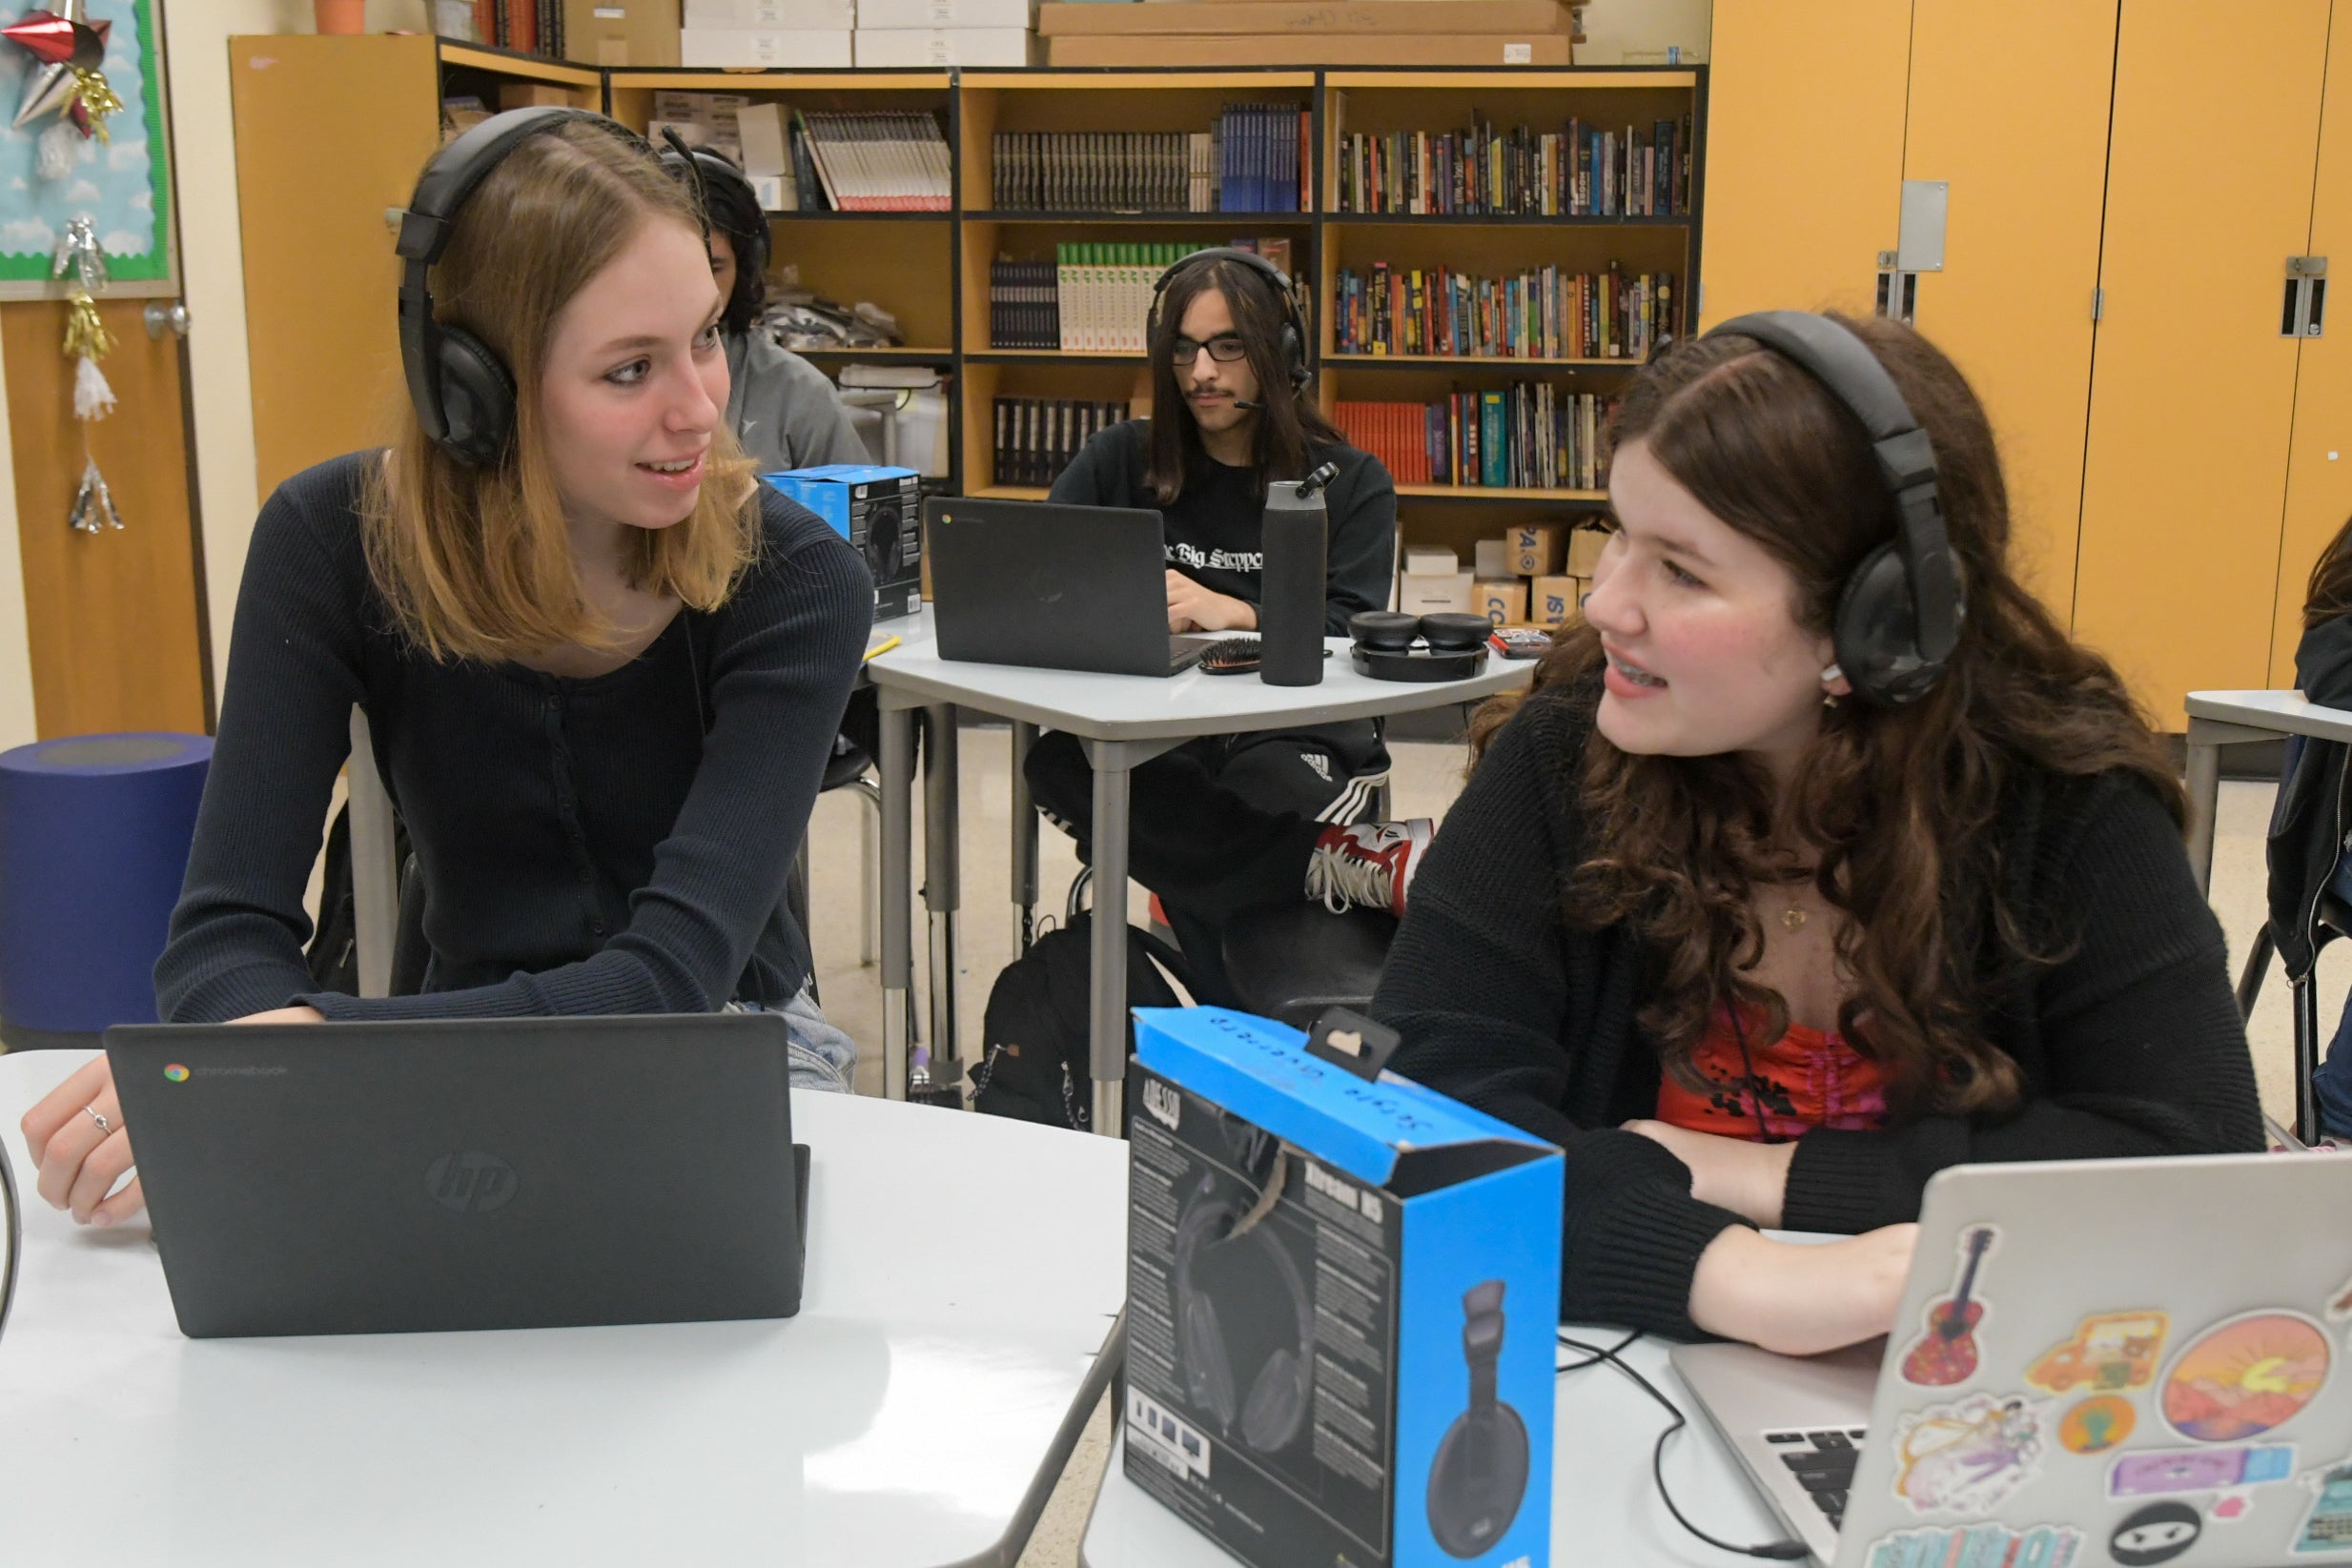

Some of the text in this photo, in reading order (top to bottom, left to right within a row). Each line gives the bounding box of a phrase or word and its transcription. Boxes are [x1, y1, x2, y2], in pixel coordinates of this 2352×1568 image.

[1060, 270, 1068, 283] AP
[1071, 270, 1078, 283] AP
[1084, 271, 1091, 283] AP
[1096, 271, 1103, 283] AP
[1108, 271, 1115, 284] AP
[1120, 271, 1127, 284] AP
[1131, 271, 1137, 284] AP
[1143, 271, 1150, 284] AP
[1176, 542, 1206, 569] Big
[1210, 548, 1263, 572] Steppe
[1300, 754, 1333, 782] adidas
[195, 1065, 288, 1077] chromebook
[440, 1154, 506, 1212] hp
